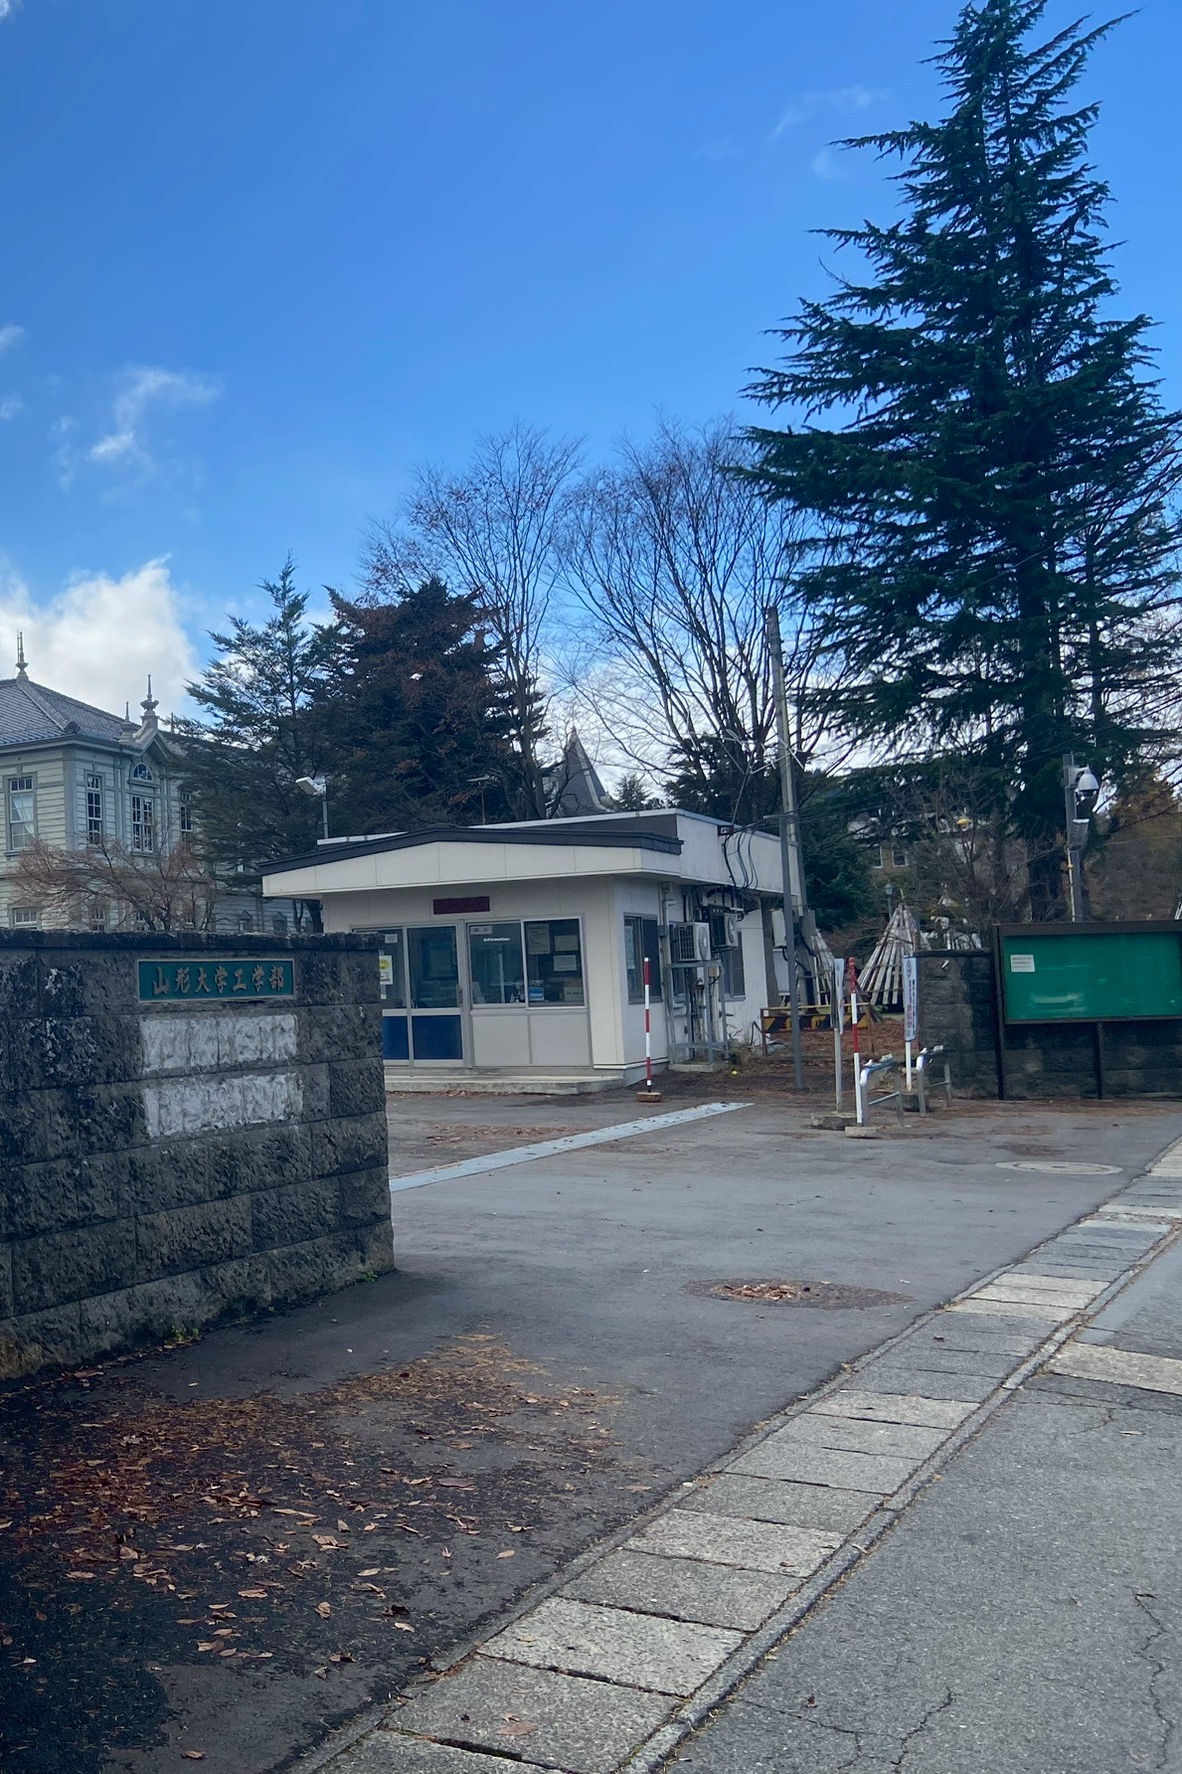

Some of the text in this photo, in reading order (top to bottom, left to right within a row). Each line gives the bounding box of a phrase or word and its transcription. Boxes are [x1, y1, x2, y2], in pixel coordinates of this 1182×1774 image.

[153, 965, 284, 996] 山形大学工学部
